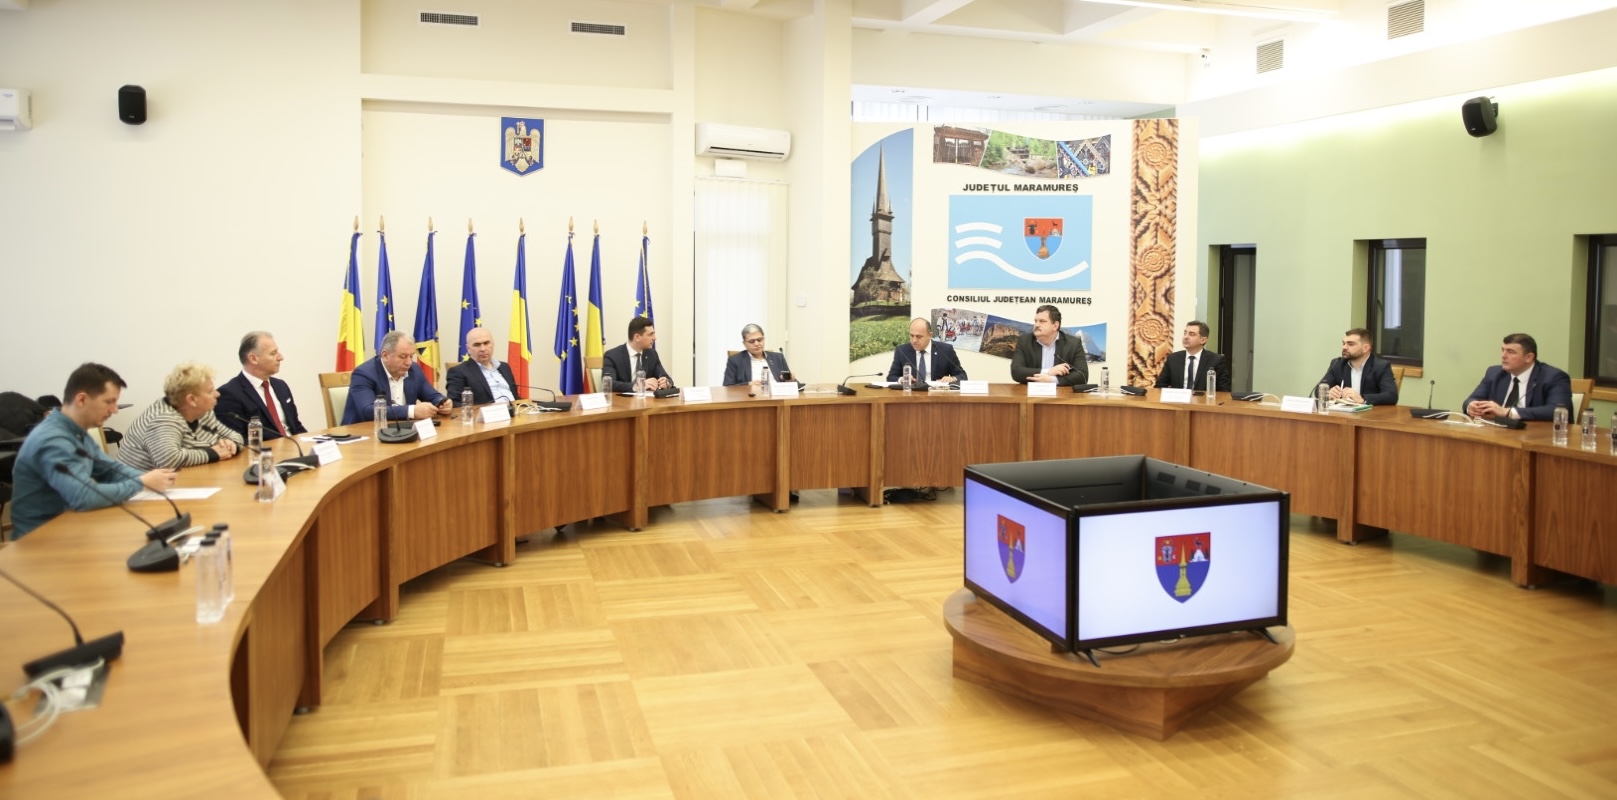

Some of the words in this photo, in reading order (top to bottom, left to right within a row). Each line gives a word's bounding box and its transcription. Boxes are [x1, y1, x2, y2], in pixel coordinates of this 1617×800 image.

[962, 183, 1010, 193] JUDEȚUL
[1013, 183, 1079, 193] MARAMUREȘ
[946, 294, 991, 303] CONSILIUL
[993, 295, 1036, 304] JUDEȚEAN
[1038, 296, 1092, 306] MARAMUREȘ
